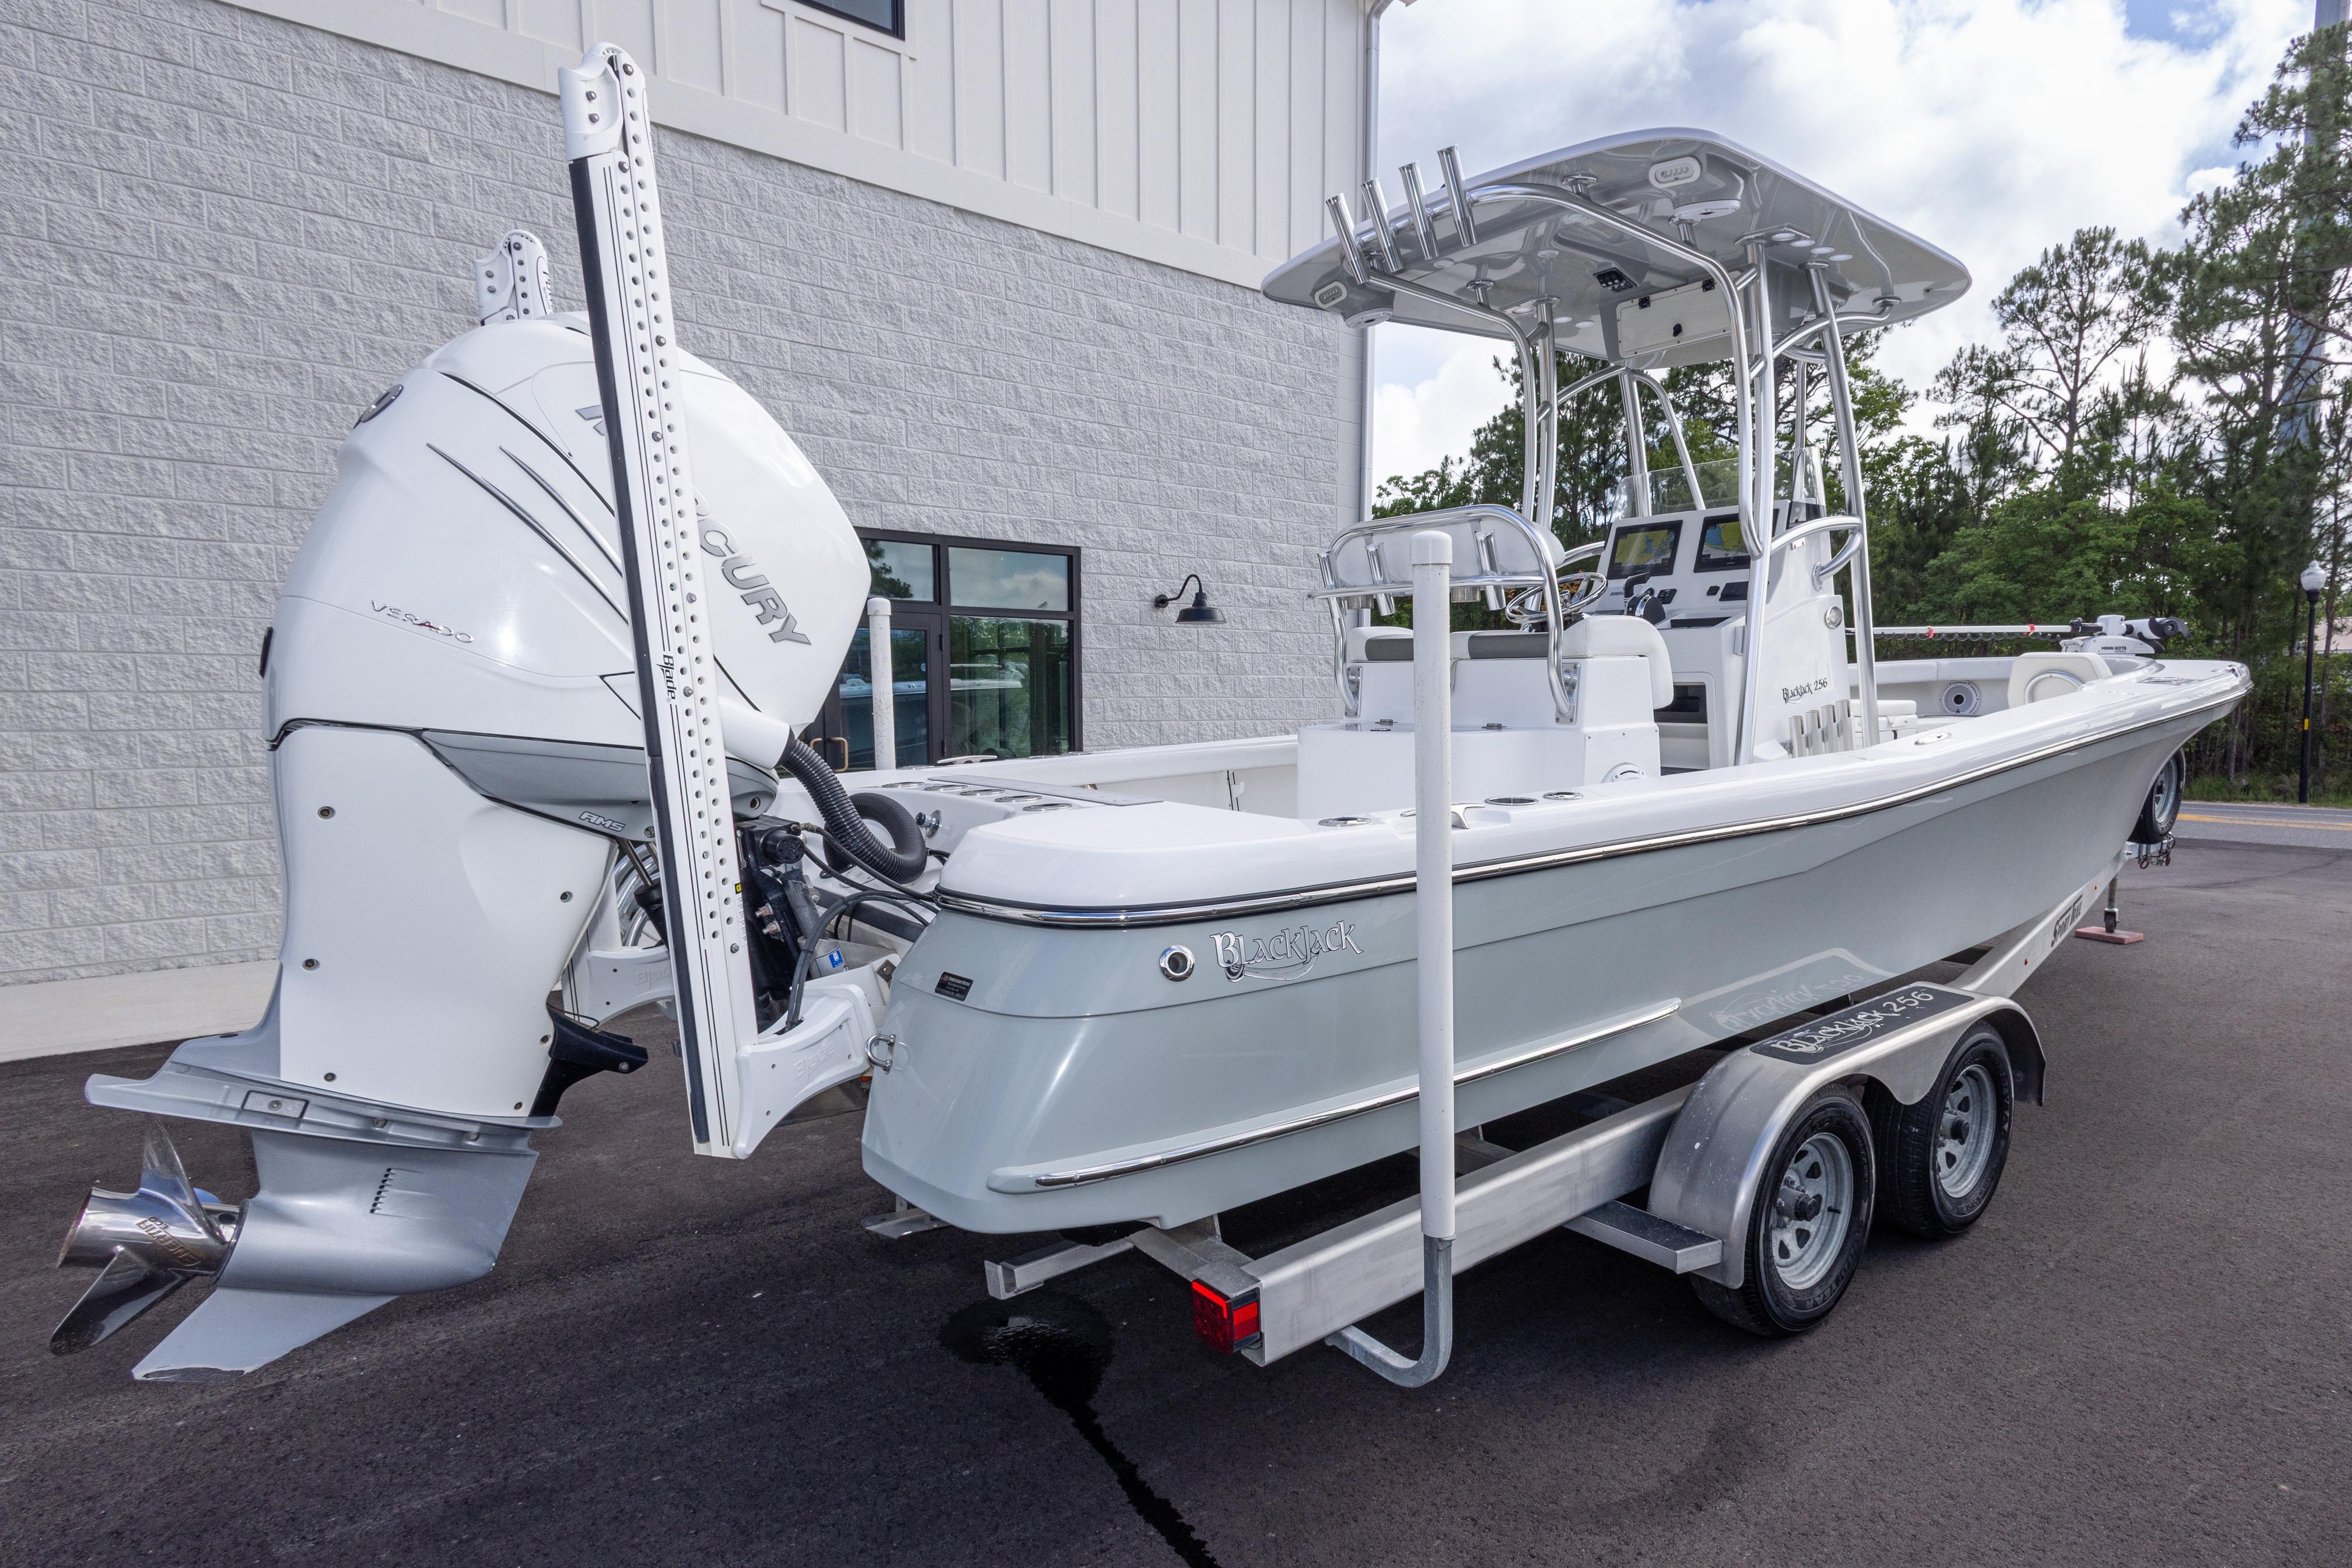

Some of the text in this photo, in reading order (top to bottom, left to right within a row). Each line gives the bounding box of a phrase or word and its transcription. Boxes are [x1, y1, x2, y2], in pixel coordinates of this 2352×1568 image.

[371, 600, 474, 643] VERADO
[655, 654, 677, 700] Blade
[1814, 677, 1828, 691] 256
[579, 811, 626, 832] AMS
[1882, 991, 1934, 1012] 256
[148, 1216, 169, 1230] ECO
